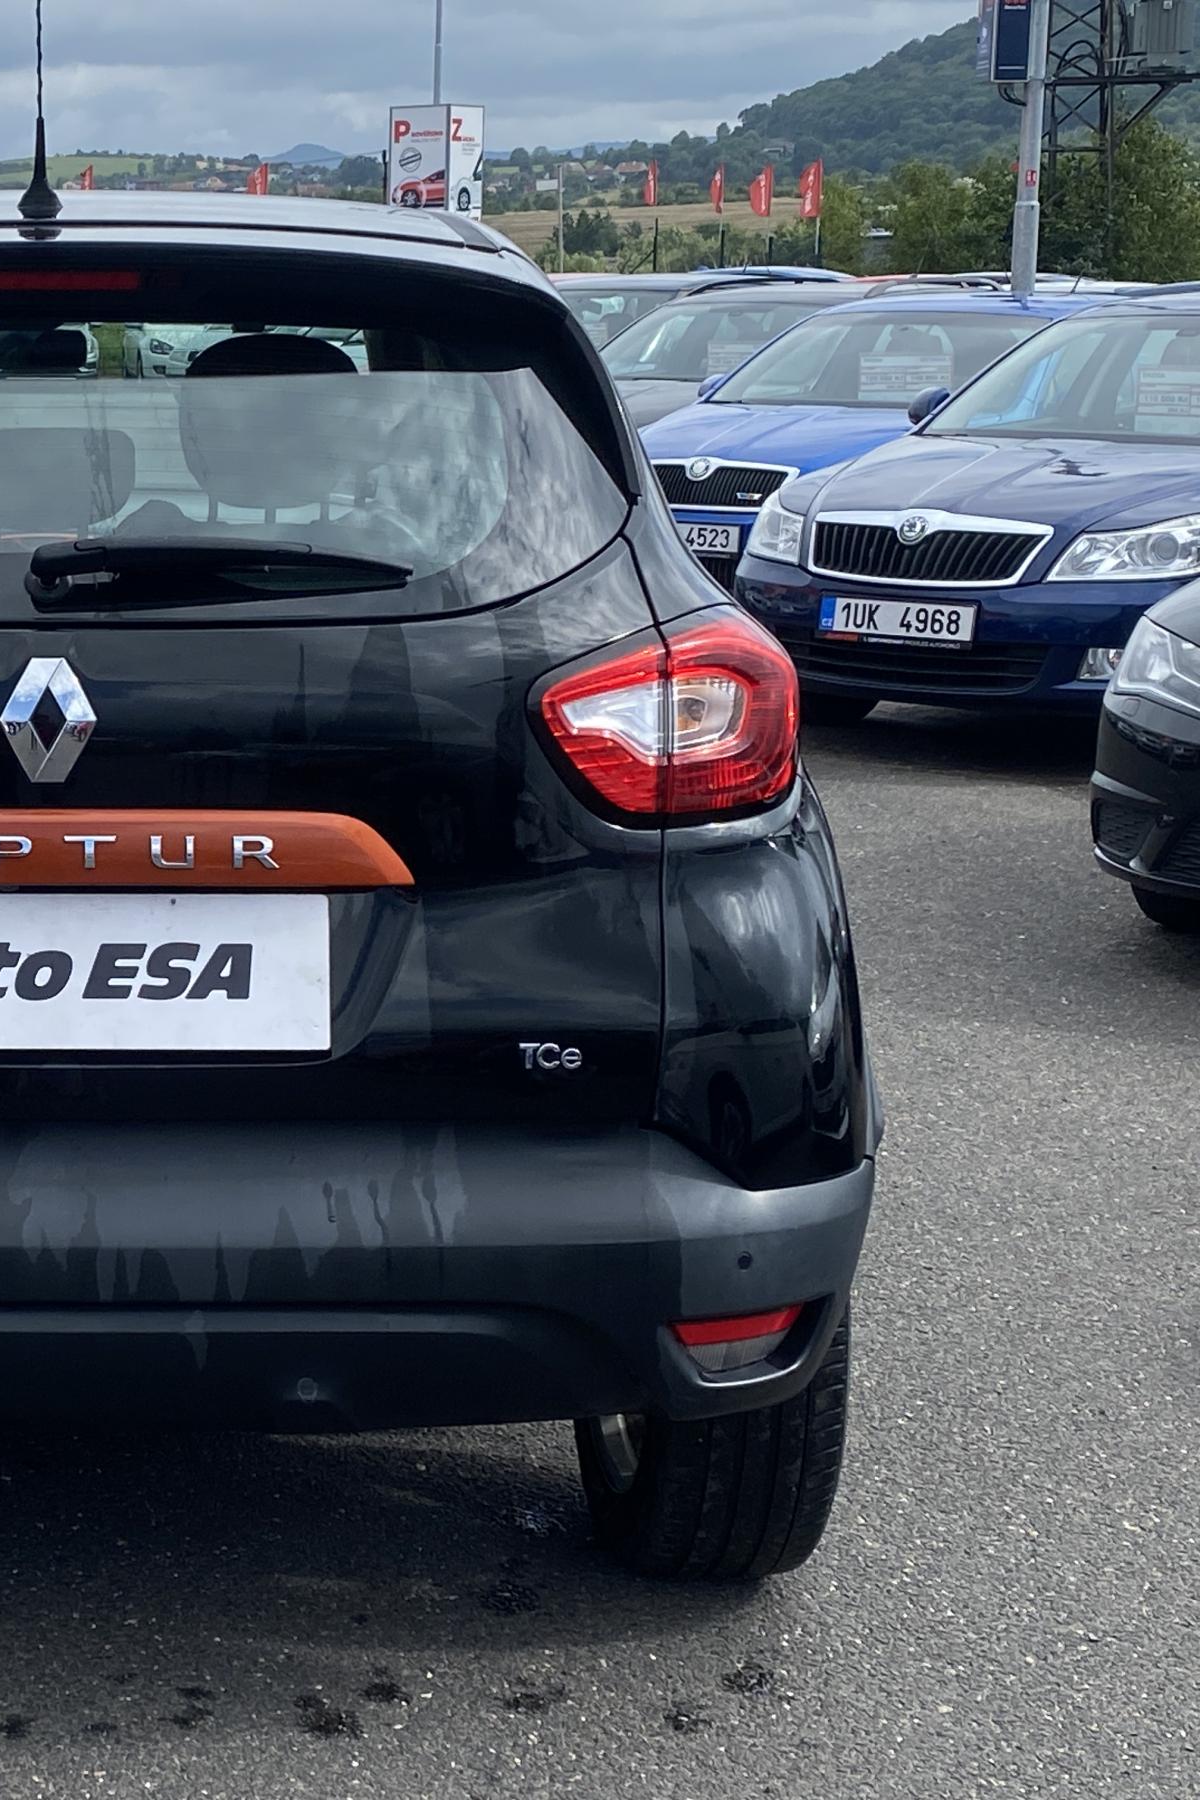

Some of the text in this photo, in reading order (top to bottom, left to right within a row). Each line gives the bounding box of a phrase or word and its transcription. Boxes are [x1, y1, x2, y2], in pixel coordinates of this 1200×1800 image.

[685, 526, 730, 548] 4523
[841, 602, 961, 635] 1UK 4968
[82, 942, 253, 1000] ESA
[518, 1042, 583, 1070] TCe
